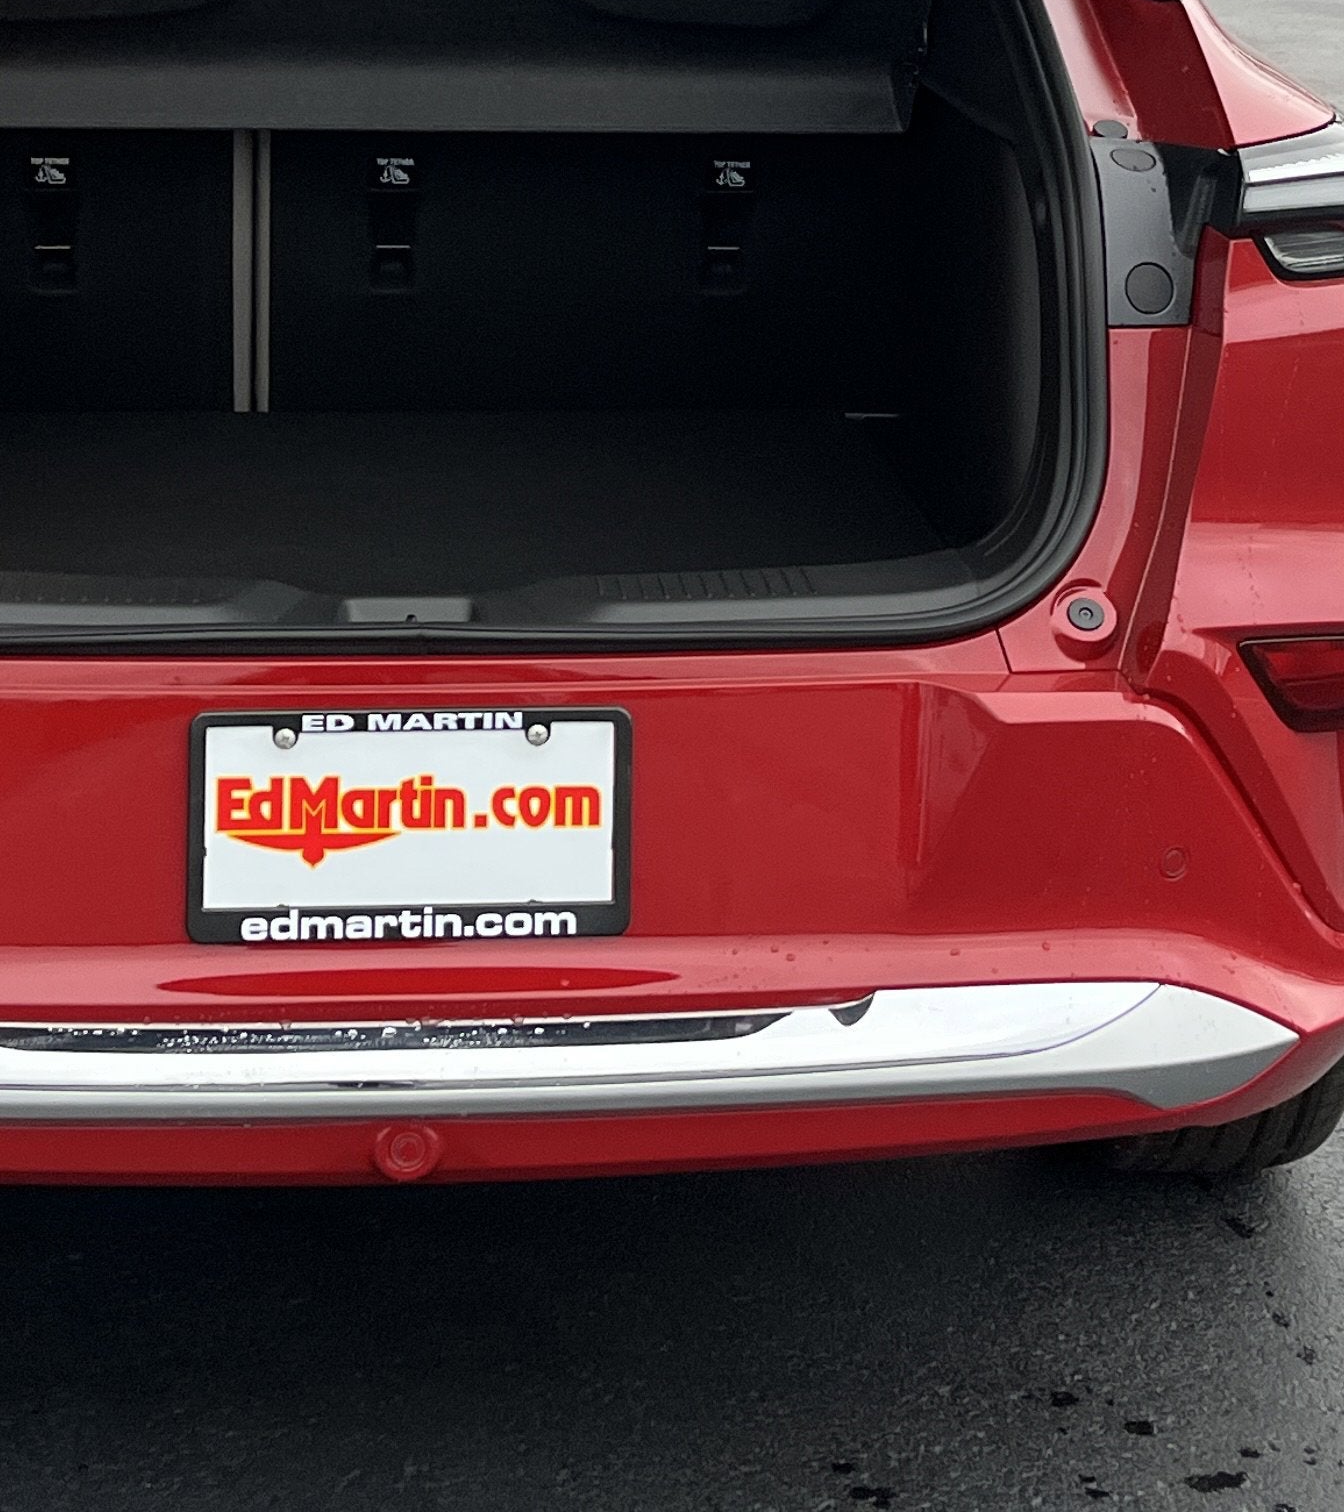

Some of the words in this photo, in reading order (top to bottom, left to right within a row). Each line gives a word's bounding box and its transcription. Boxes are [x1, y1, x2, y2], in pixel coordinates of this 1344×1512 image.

[301, 714, 355, 732] ED
[367, 711, 523, 731] MARTIN
[215, 774, 603, 846] EdMartin.com
[240, 906, 578, 941] edmartin.com
